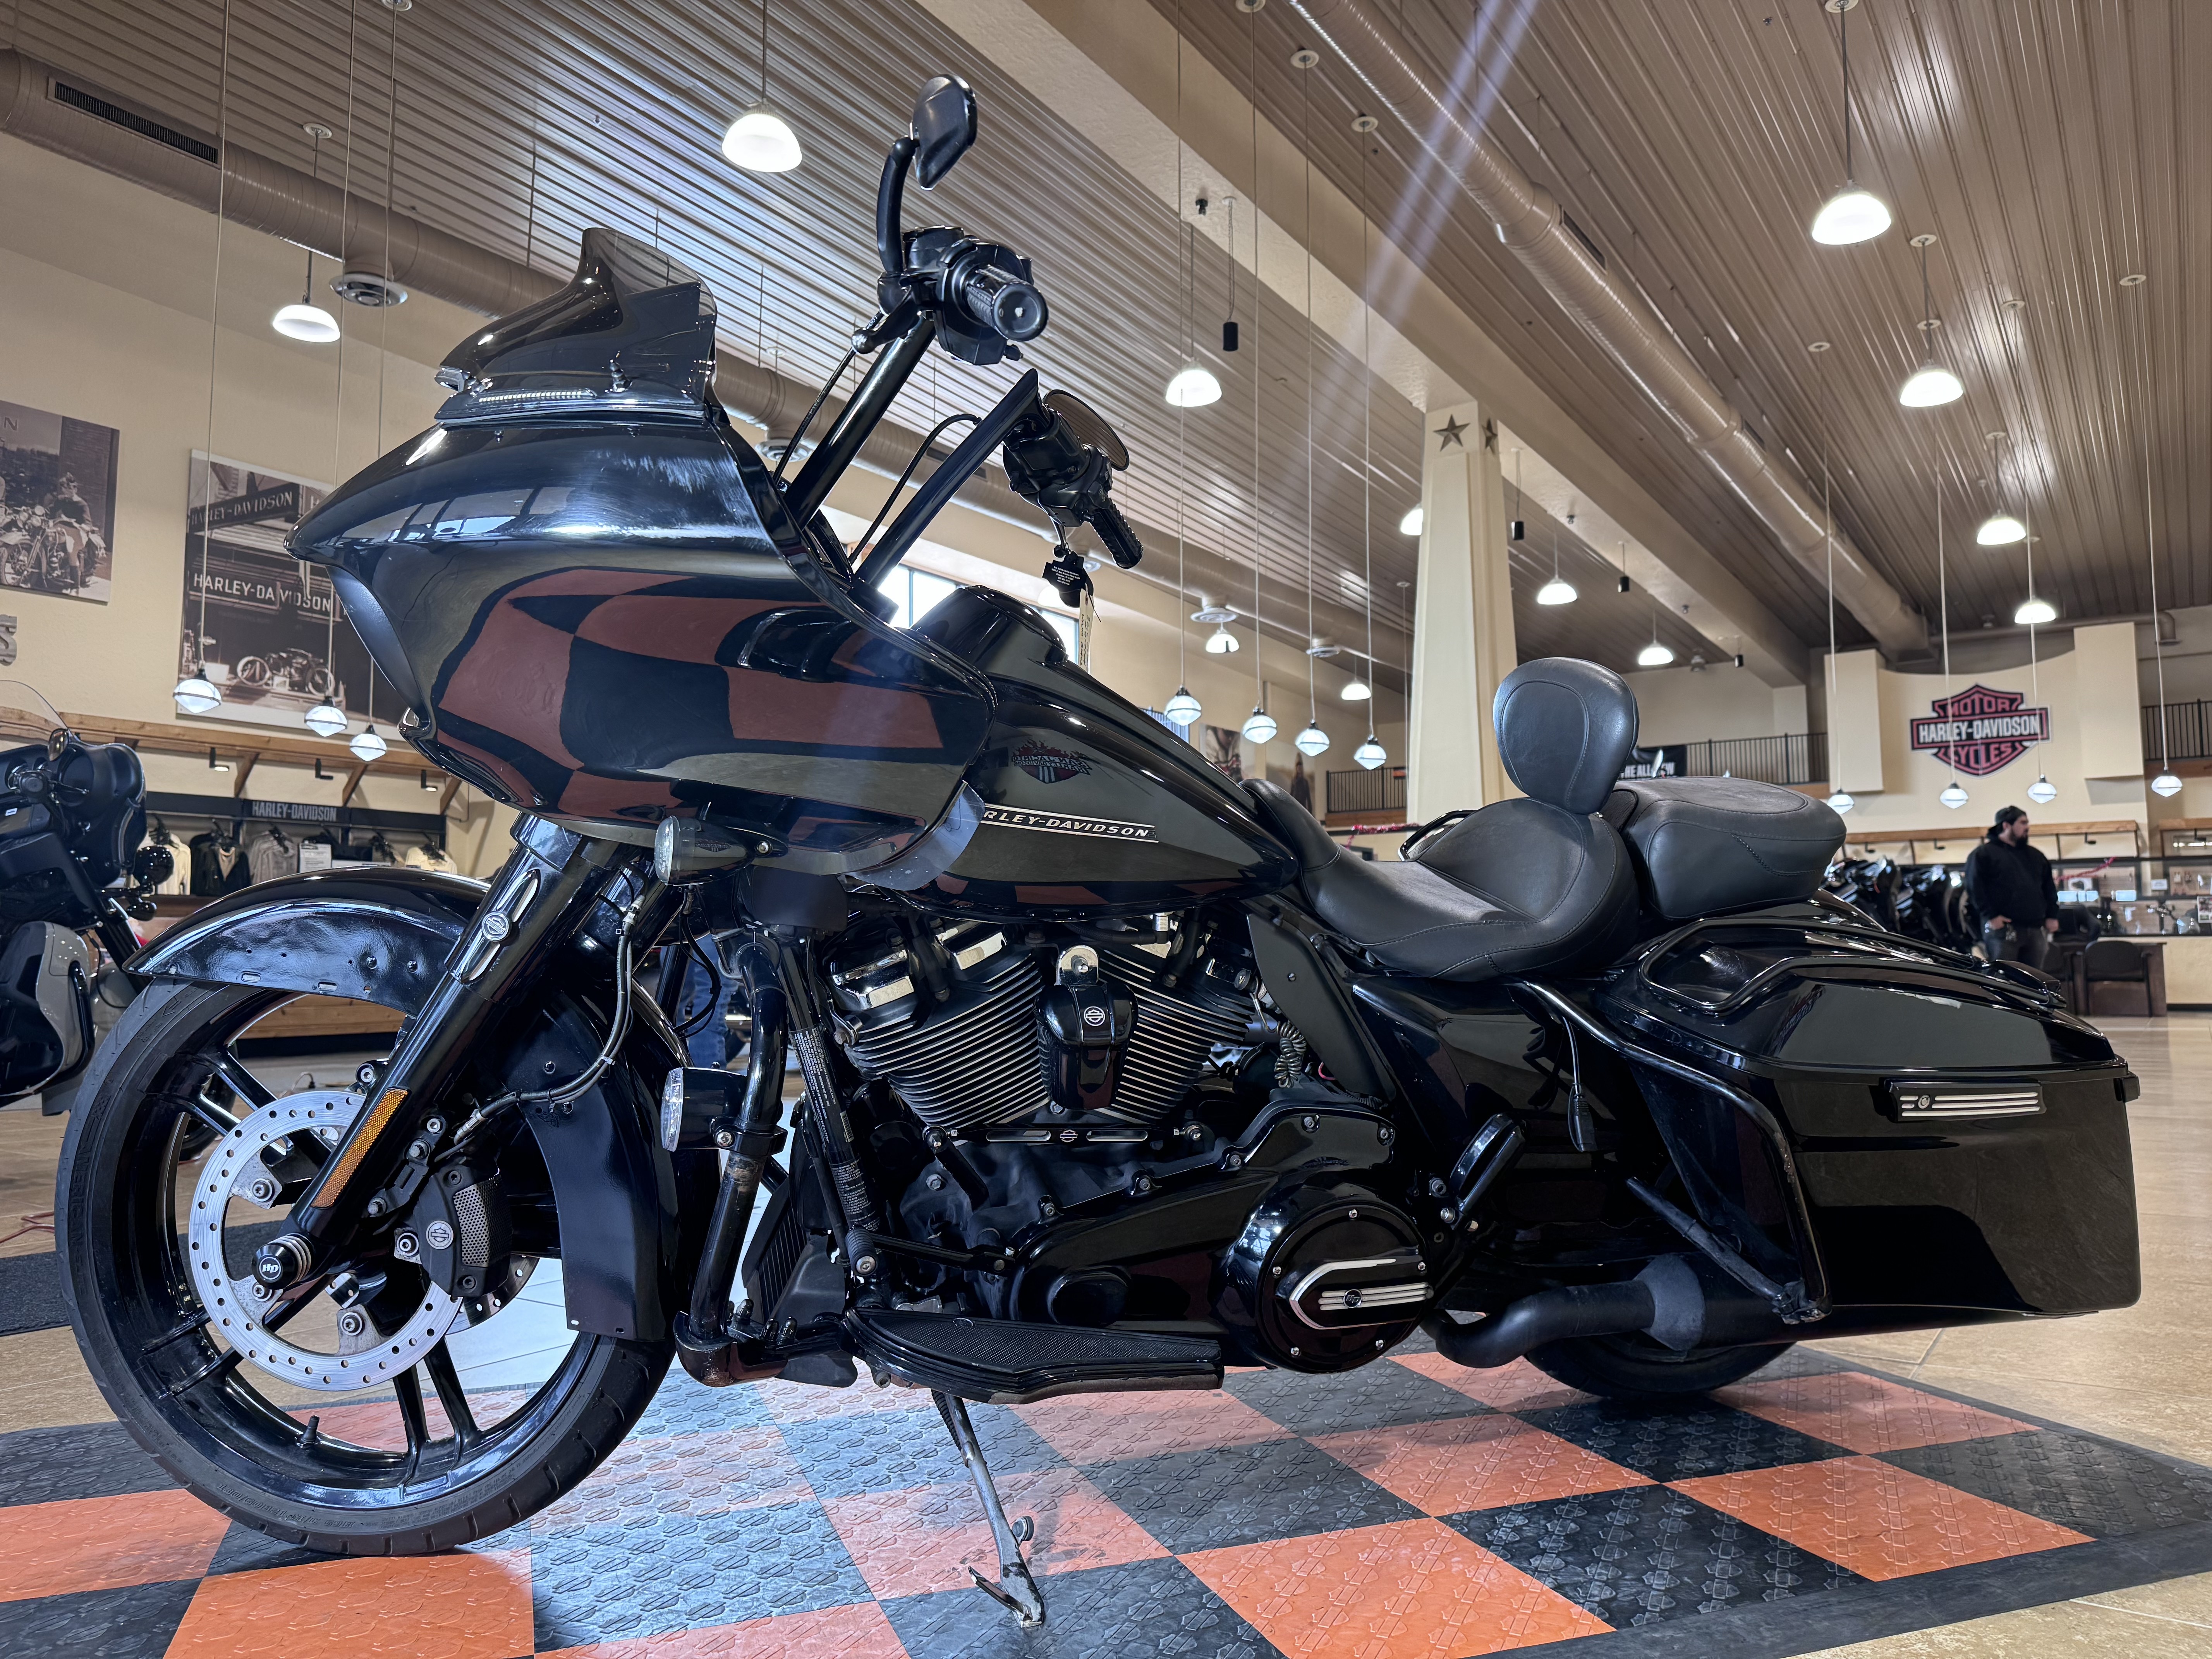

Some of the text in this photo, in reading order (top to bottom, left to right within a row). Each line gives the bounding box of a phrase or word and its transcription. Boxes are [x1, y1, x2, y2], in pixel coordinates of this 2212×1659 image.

[191, 491, 292, 525] HALEY-DAVIDSON
[1946, 696, 2011, 716] MOTOR
[1919, 714, 2039, 744] HARLEY-DAVIDSON
[1948, 742, 2013, 768] CYCLES
[252, 801, 337, 821] HARLEY-DAVIDSON
[262, 1263, 279, 1273] HD
